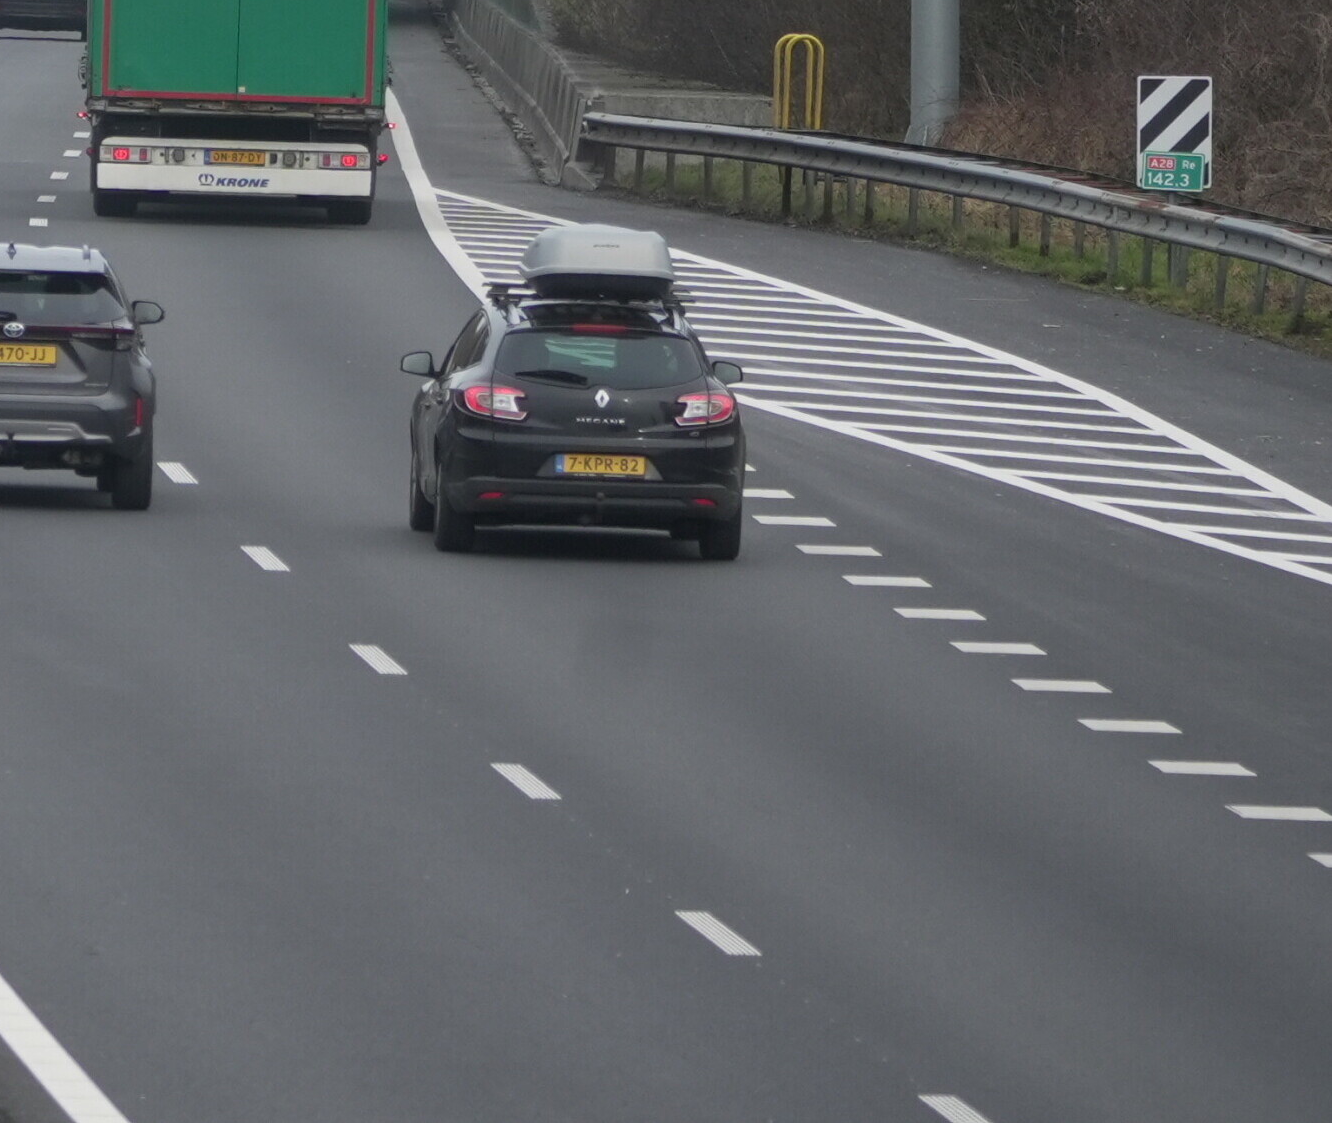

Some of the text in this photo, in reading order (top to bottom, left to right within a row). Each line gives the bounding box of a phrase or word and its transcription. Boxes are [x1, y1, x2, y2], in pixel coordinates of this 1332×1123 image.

[1150, 158, 1196, 170] A28 Re
[215, 177, 271, 188] KRONE
[1148, 173, 1190, 187] 142.3
[568, 456, 640, 473] 7-KPR-82
